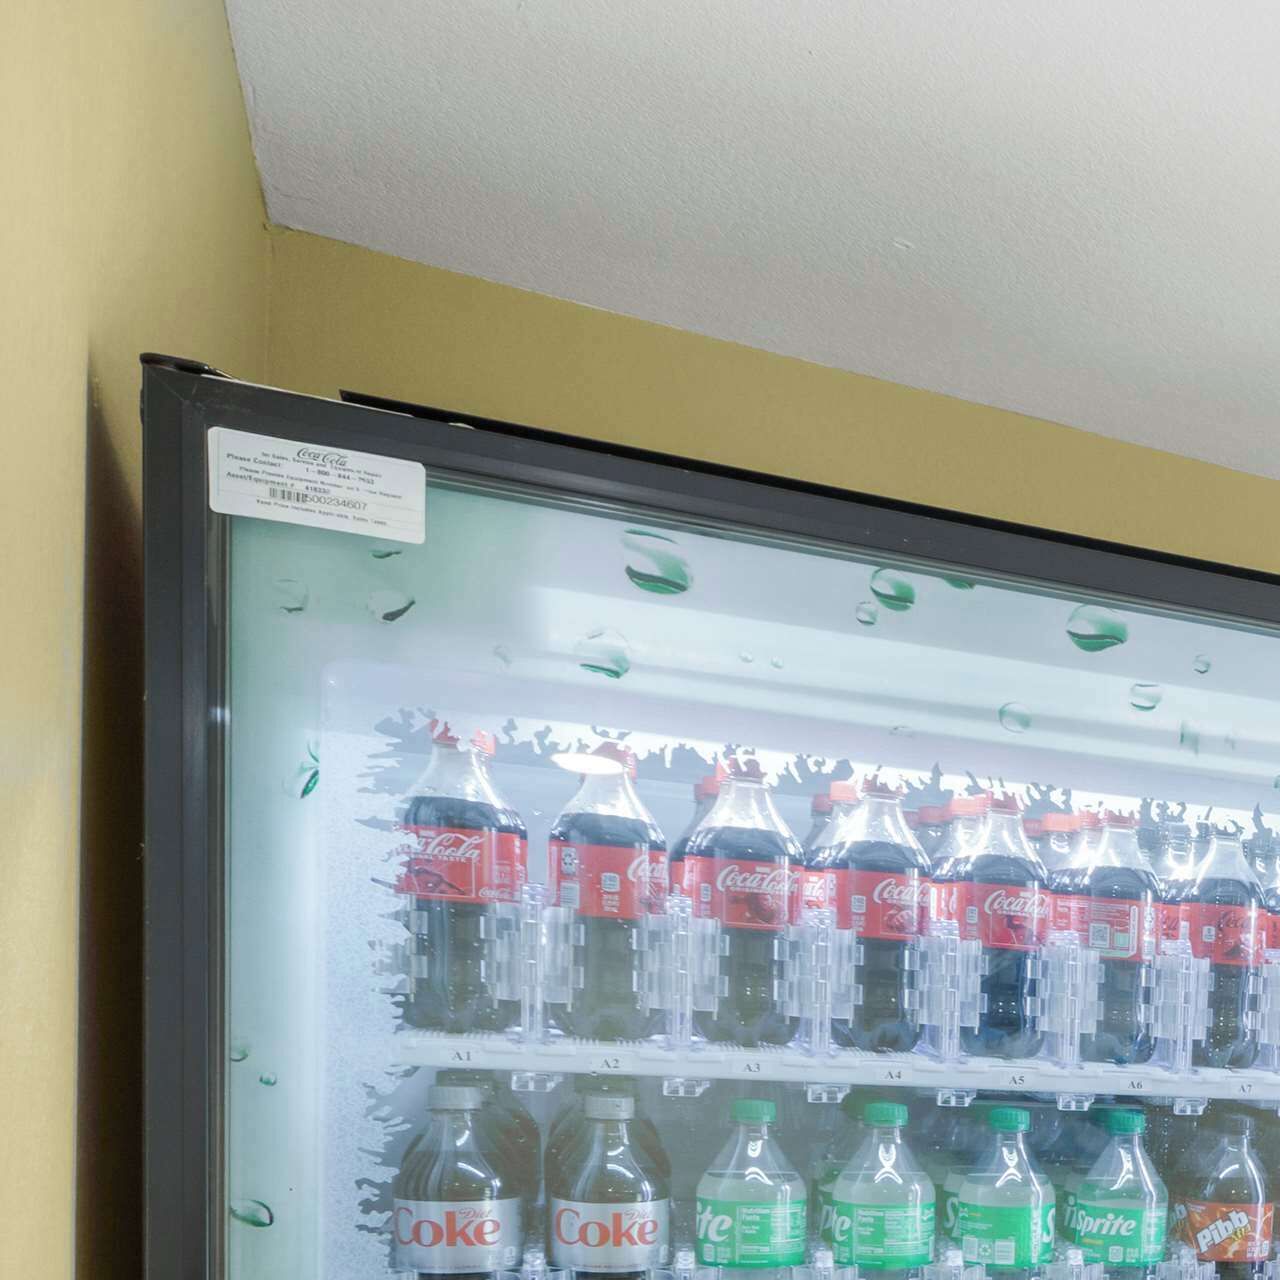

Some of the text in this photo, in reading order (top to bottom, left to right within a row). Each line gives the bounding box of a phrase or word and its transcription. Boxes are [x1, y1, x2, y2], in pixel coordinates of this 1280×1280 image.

[452, 1051, 471, 1061] A1
[601, 1059, 620, 1069] A2
[743, 1063, 761, 1073] A3
[885, 1071, 901, 1080] A4
[1009, 1075, 1025, 1085] A5
[1127, 1081, 1143, 1090] A6
[1239, 1084, 1252, 1093] A7
[394, 1206, 500, 1247] Coke
[555, 1207, 659, 1247] Coke
[1077, 1211, 1137, 1237] Sprite
[1196, 1210, 1249, 1254] Pibb
